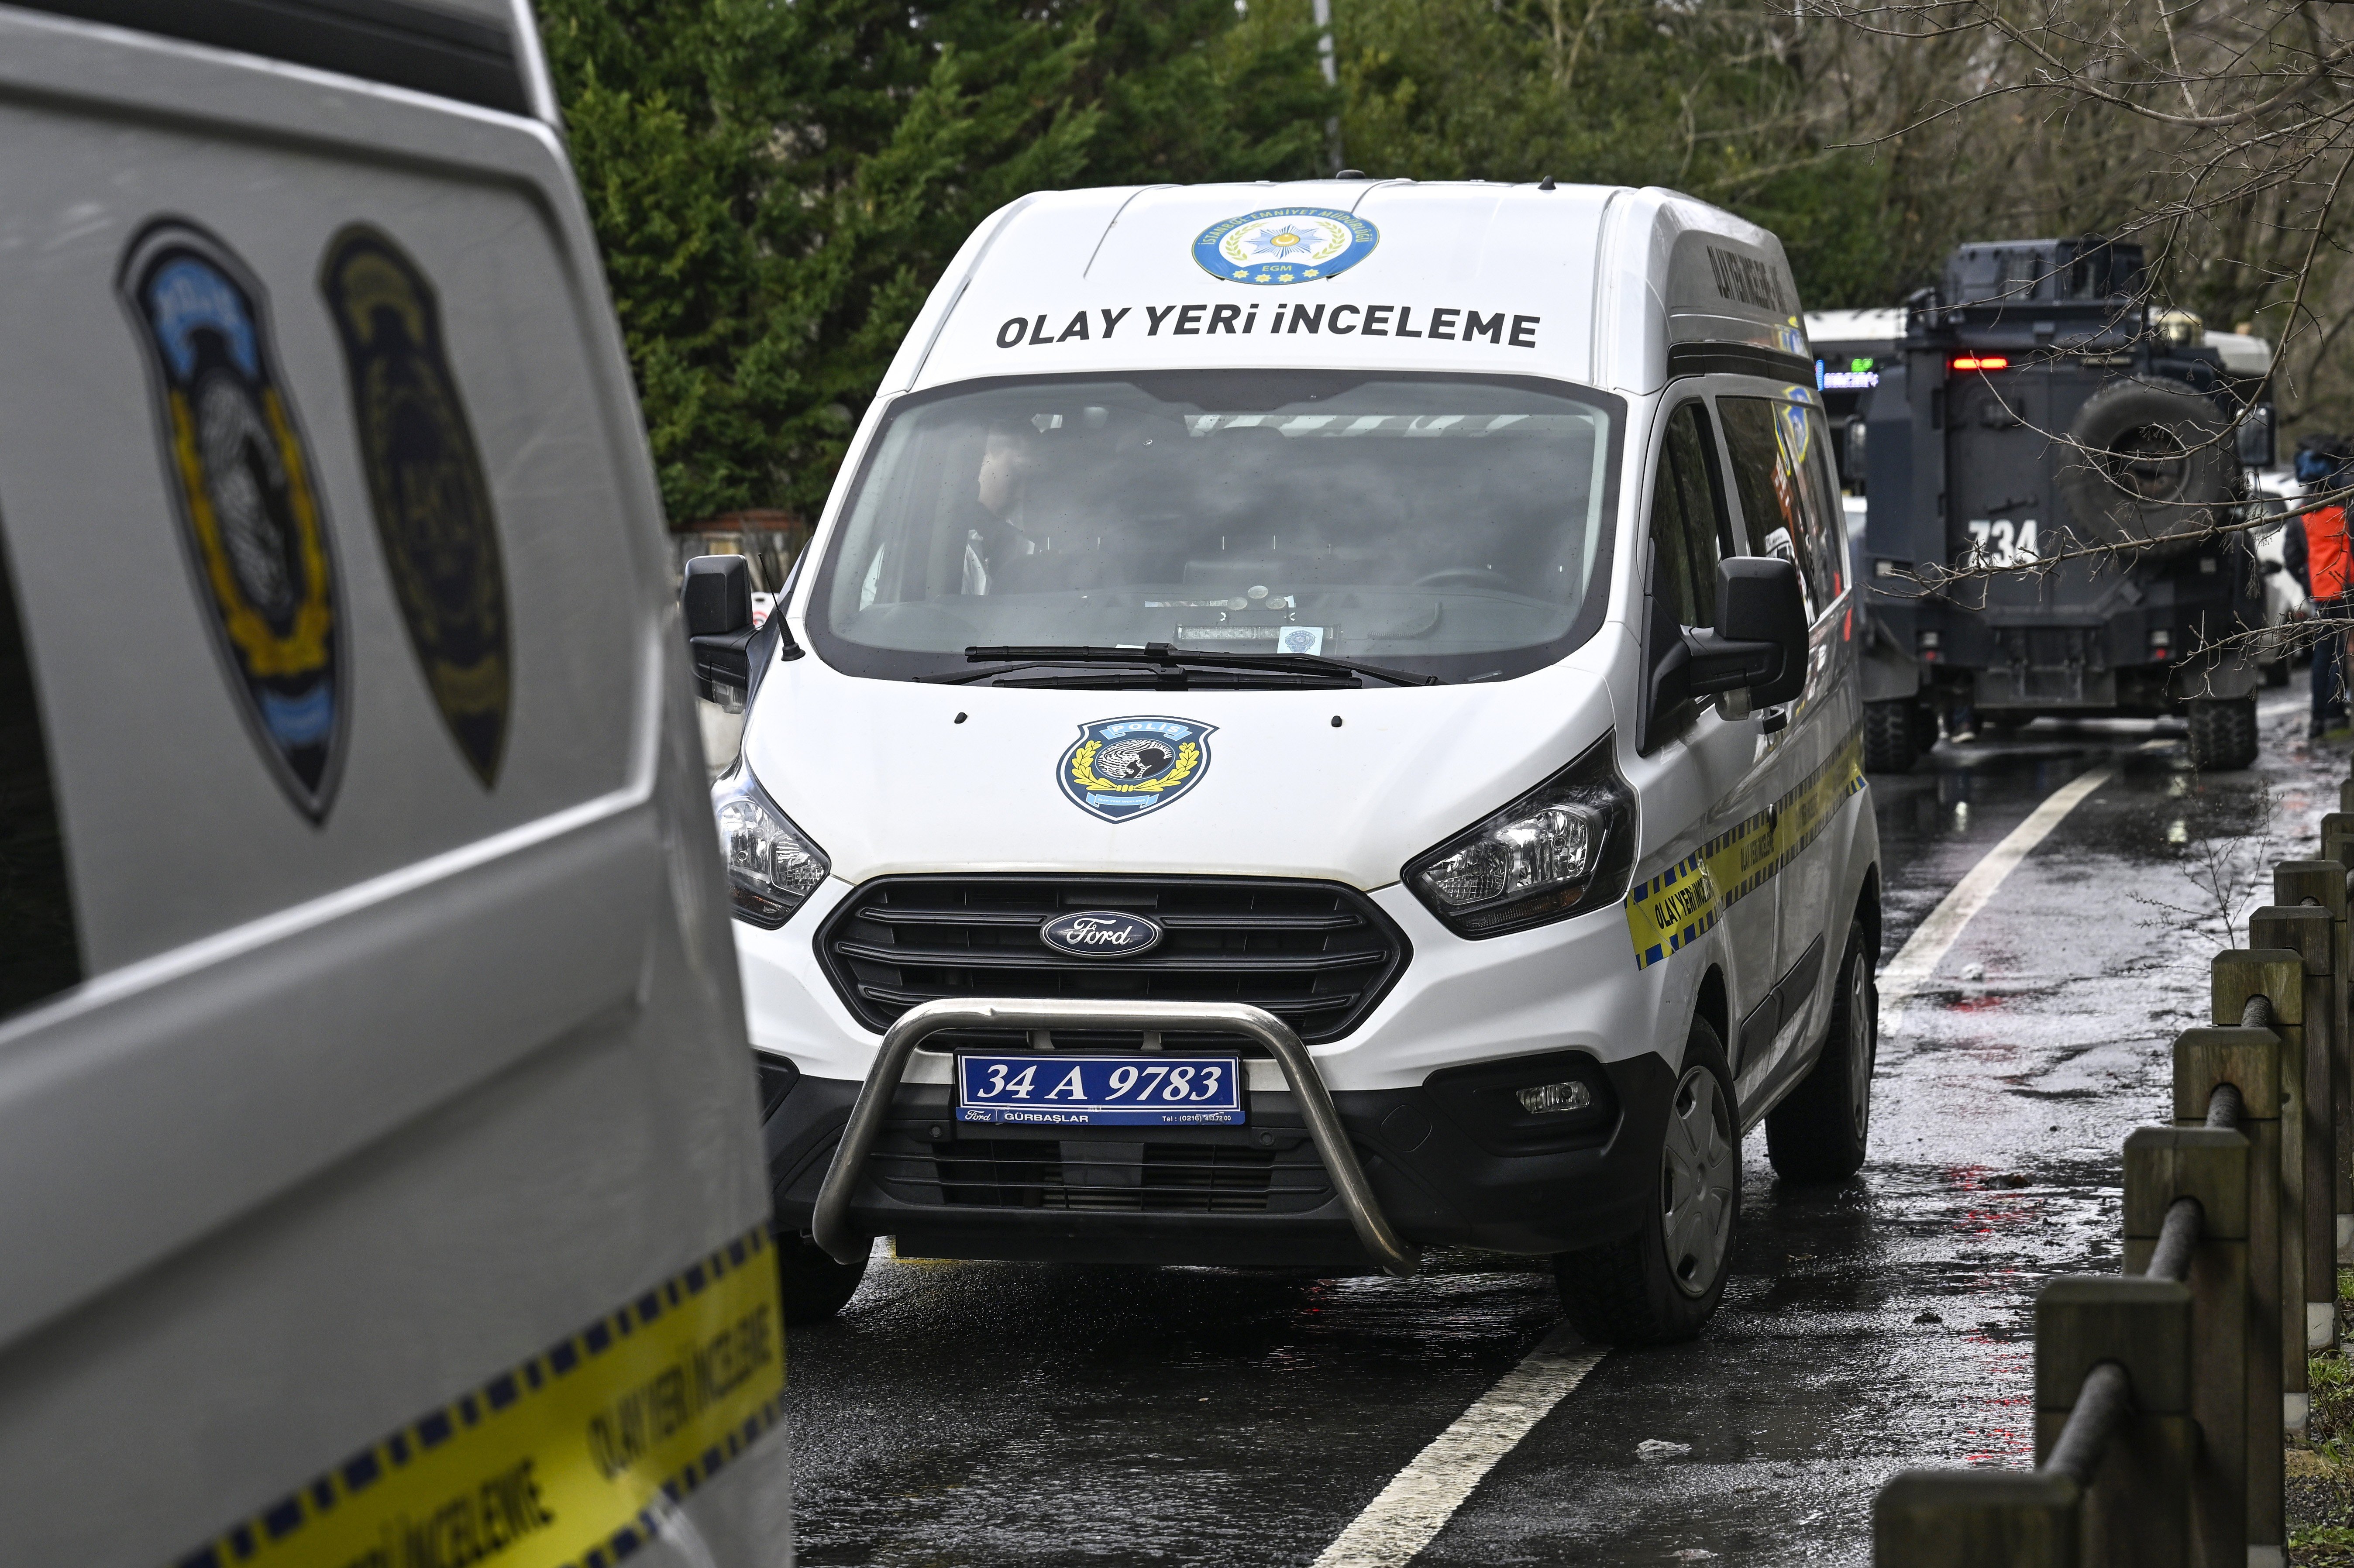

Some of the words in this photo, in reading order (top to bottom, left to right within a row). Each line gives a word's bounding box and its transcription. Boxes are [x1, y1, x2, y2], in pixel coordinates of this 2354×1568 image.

[996, 307, 1132, 349] OLAY
[1968, 518, 2040, 571] 734
[1655, 895, 1681, 929] OLAY
[1066, 918, 1133, 945] Ford
[977, 1064, 1038, 1099] 34
[1044, 1065, 1088, 1100] A
[1105, 1066, 1222, 1100] 9783
[964, 1110, 991, 1121] Ford
[1004, 1112, 1089, 1123] GÜRBAŞLAR
